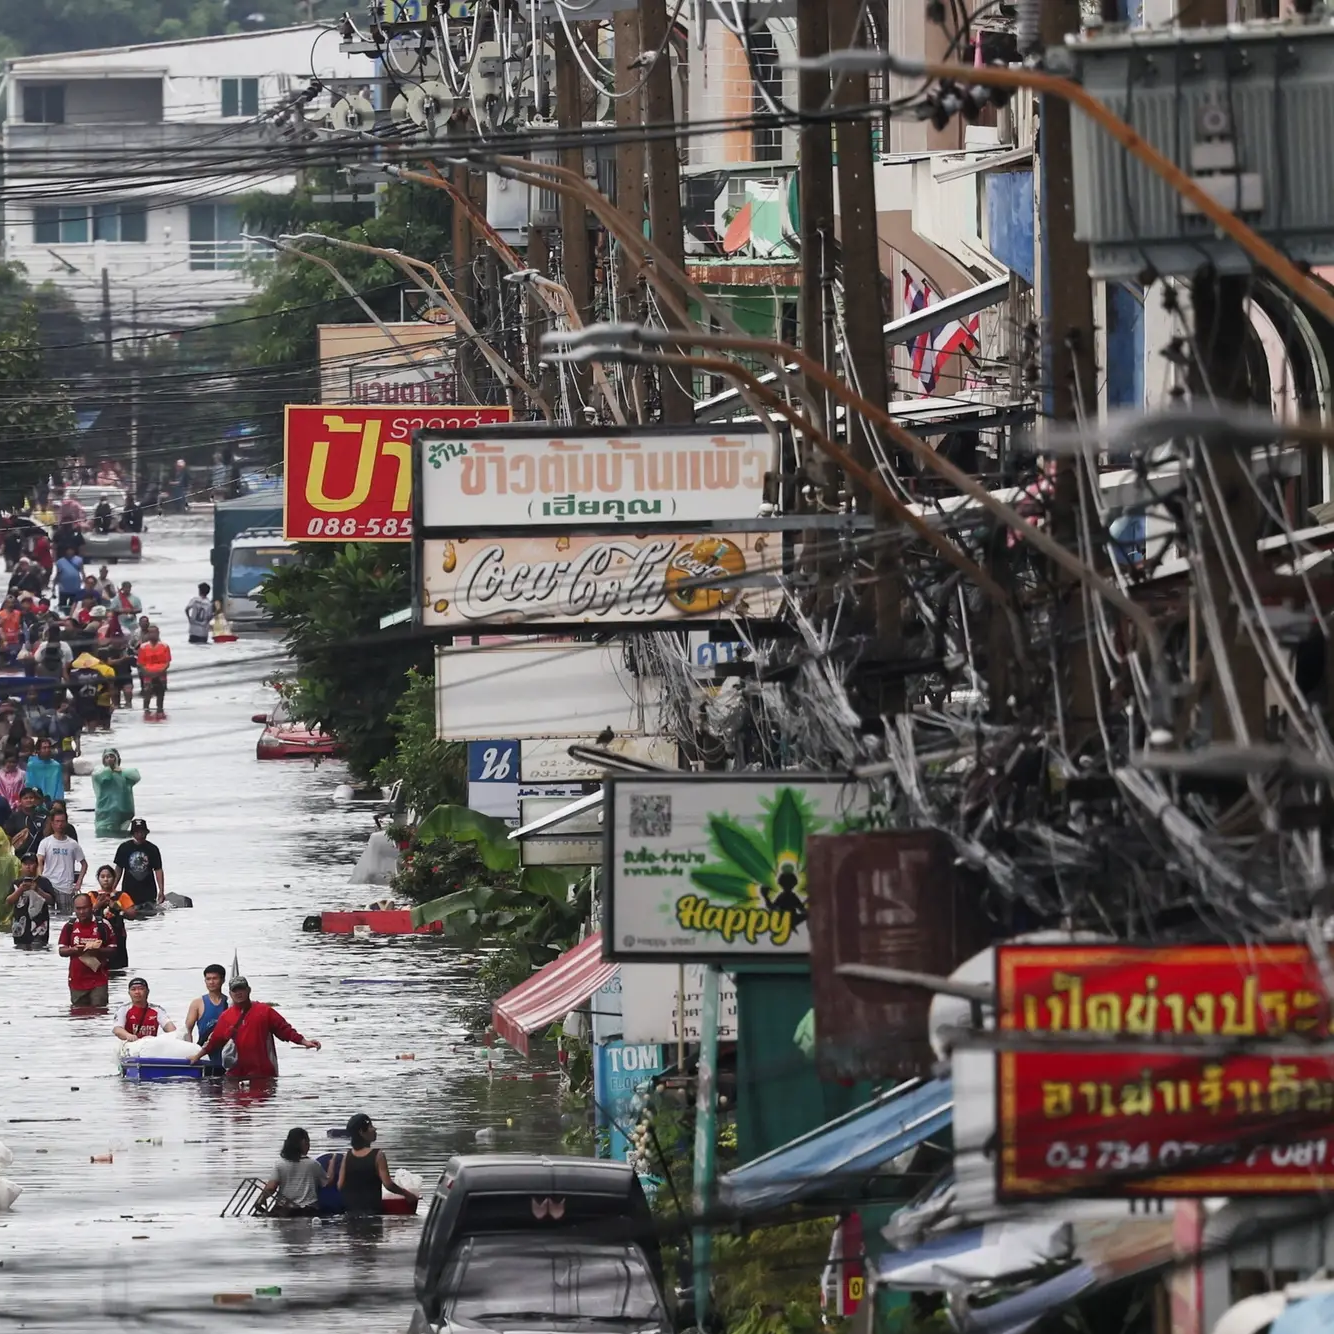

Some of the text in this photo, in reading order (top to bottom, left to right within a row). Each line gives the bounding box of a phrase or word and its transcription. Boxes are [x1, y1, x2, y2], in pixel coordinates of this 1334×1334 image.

[427, 442, 468, 470] ร้าน
[460, 436, 767, 496] ข้าวต้มบ้านแพ้ว
[454, 540, 675, 618] Coca-Cola
[677, 895, 792, 945] Happy
[1023, 971, 1334, 1036] เป็ดย่างประ
[606, 1045, 659, 1073] TOM
